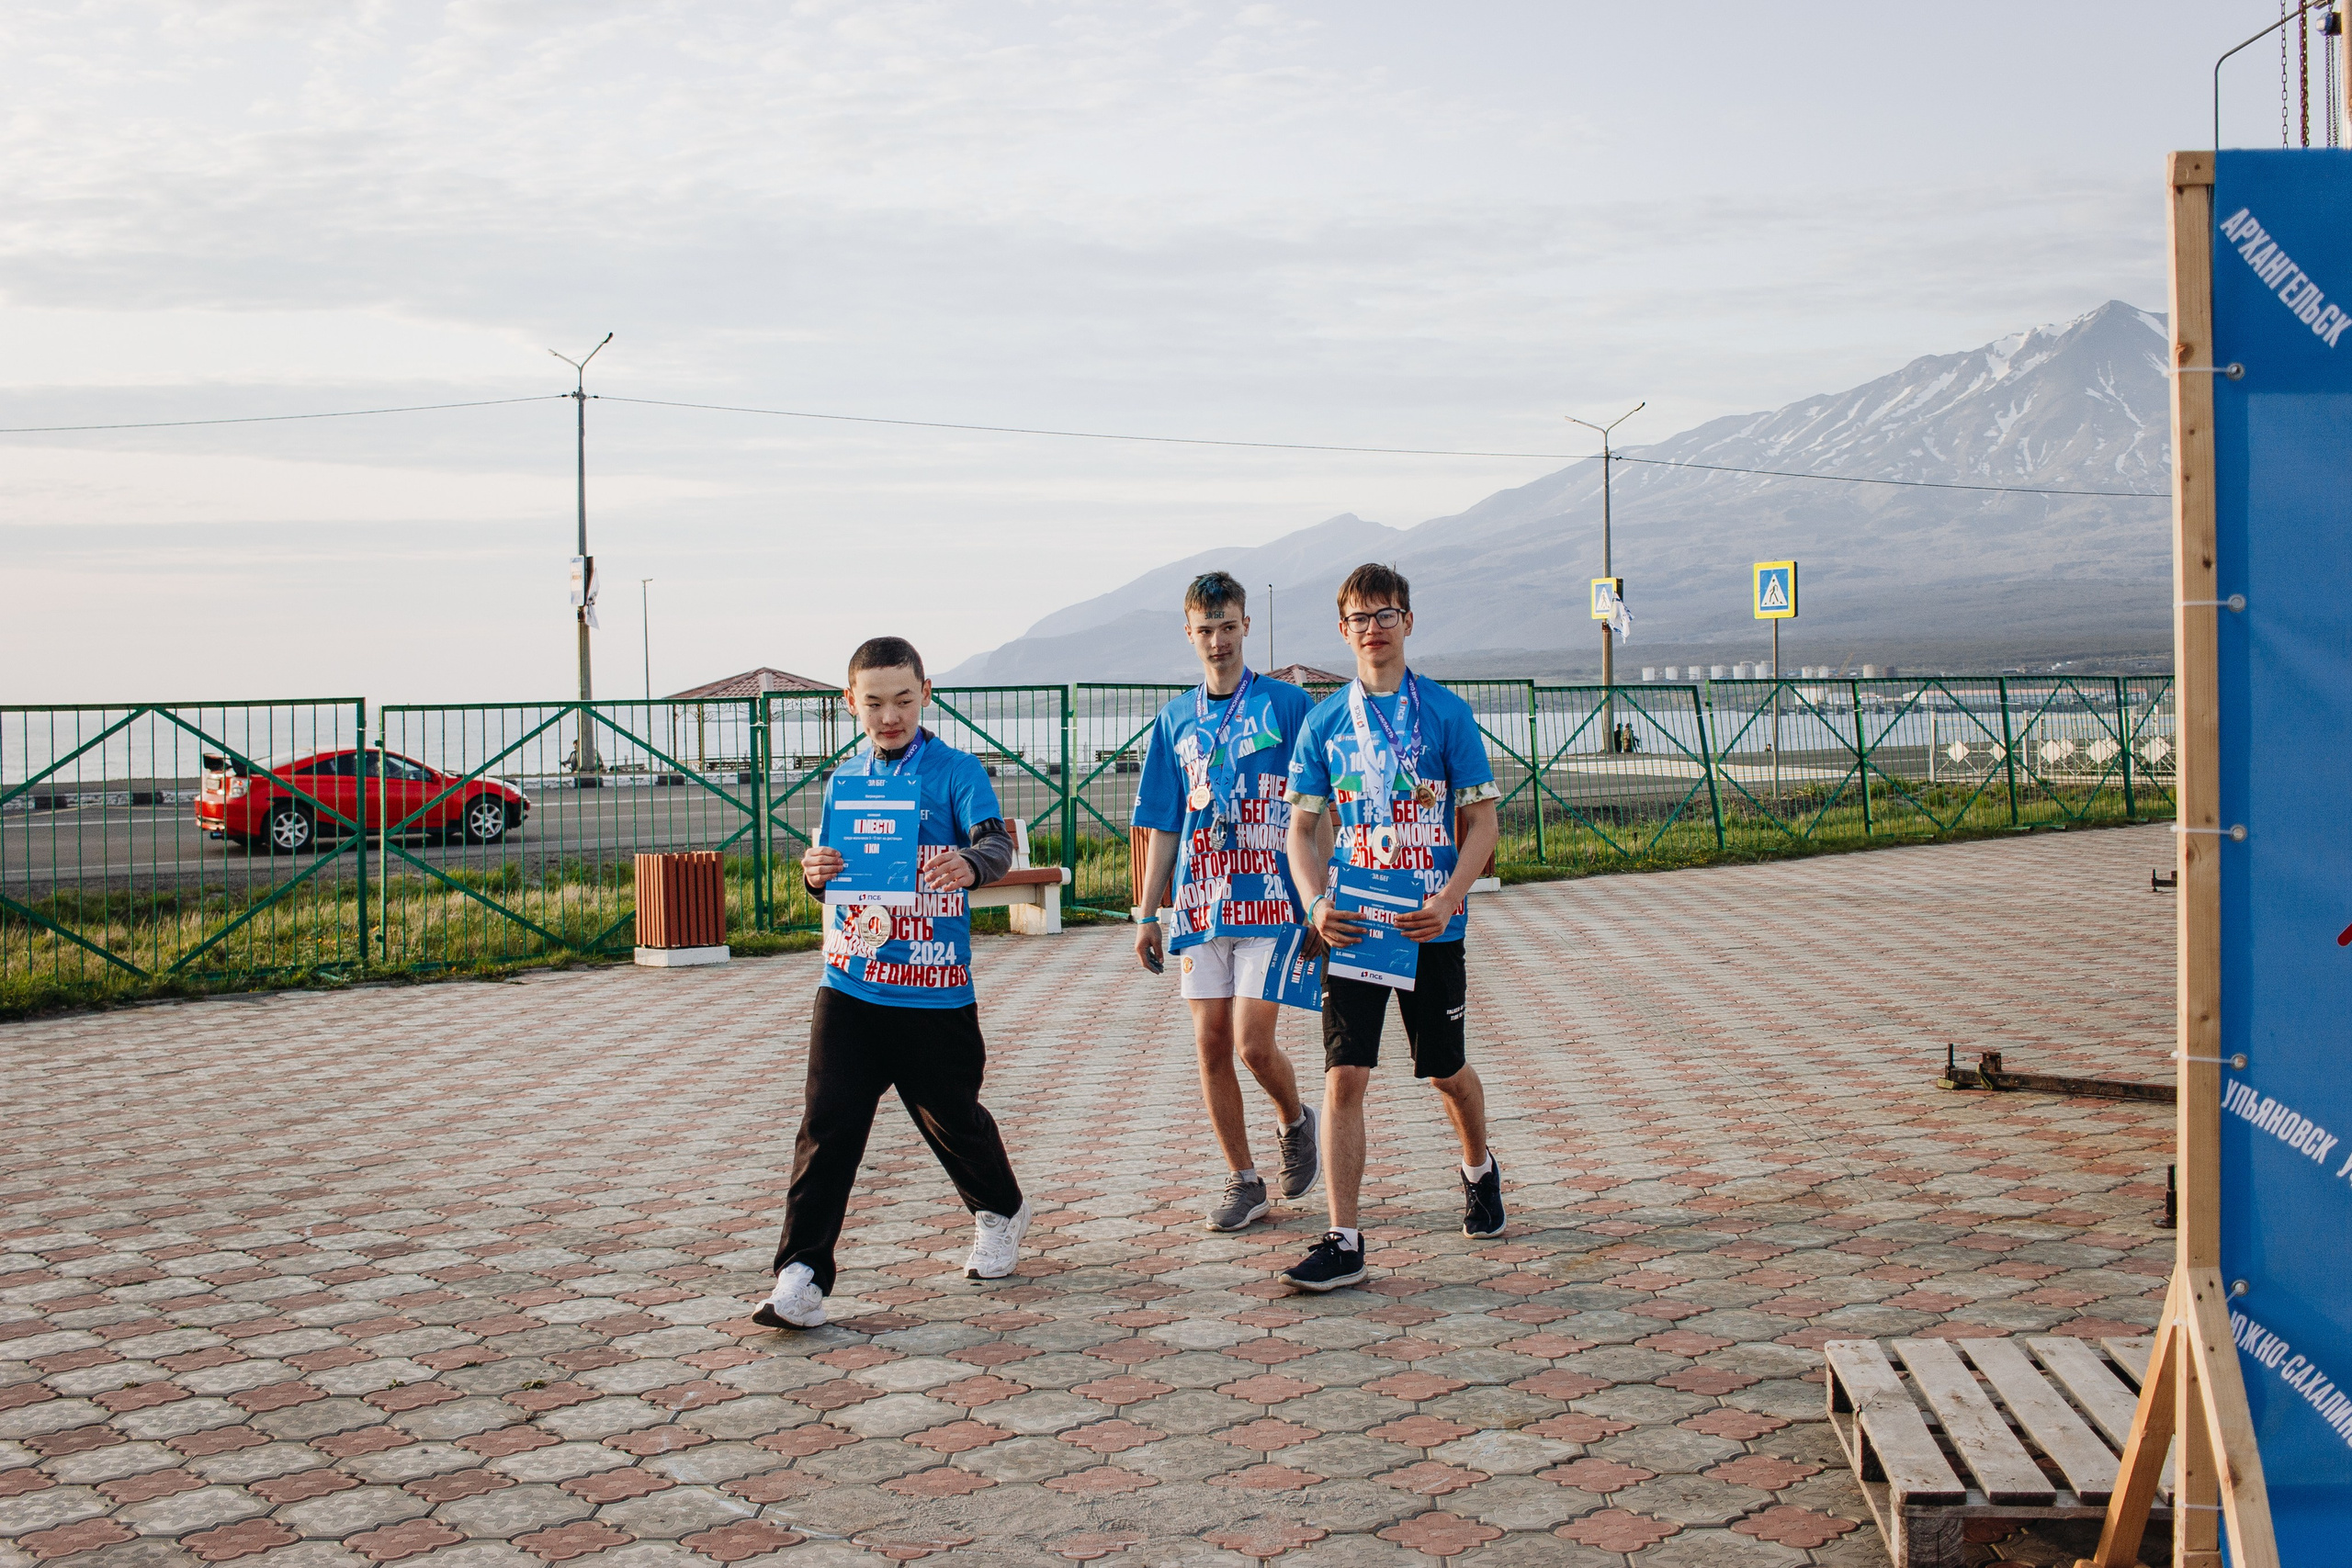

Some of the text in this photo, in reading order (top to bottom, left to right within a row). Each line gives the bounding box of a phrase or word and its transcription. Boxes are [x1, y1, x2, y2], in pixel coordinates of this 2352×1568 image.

[2220, 207, 2351, 348] АРХАНГЕЛЬСК
[1353, 705, 1363, 720] ПСБ
[1396, 705, 1407, 721] ПСБ
[1378, 714, 1394, 739] ОБЛАСТЬ
[863, 818, 896, 834] МЕСТО
[1190, 849, 1280, 880] #ГОРДОСТЬ
[908, 942, 956, 965] 2024
[865, 959, 969, 987] #ЕДИНСТВО
[2221, 1078, 2339, 1165] УЛЬЯНОВСК
[2231, 1311, 2352, 1448] ЮЖНО-САХАЛИН
